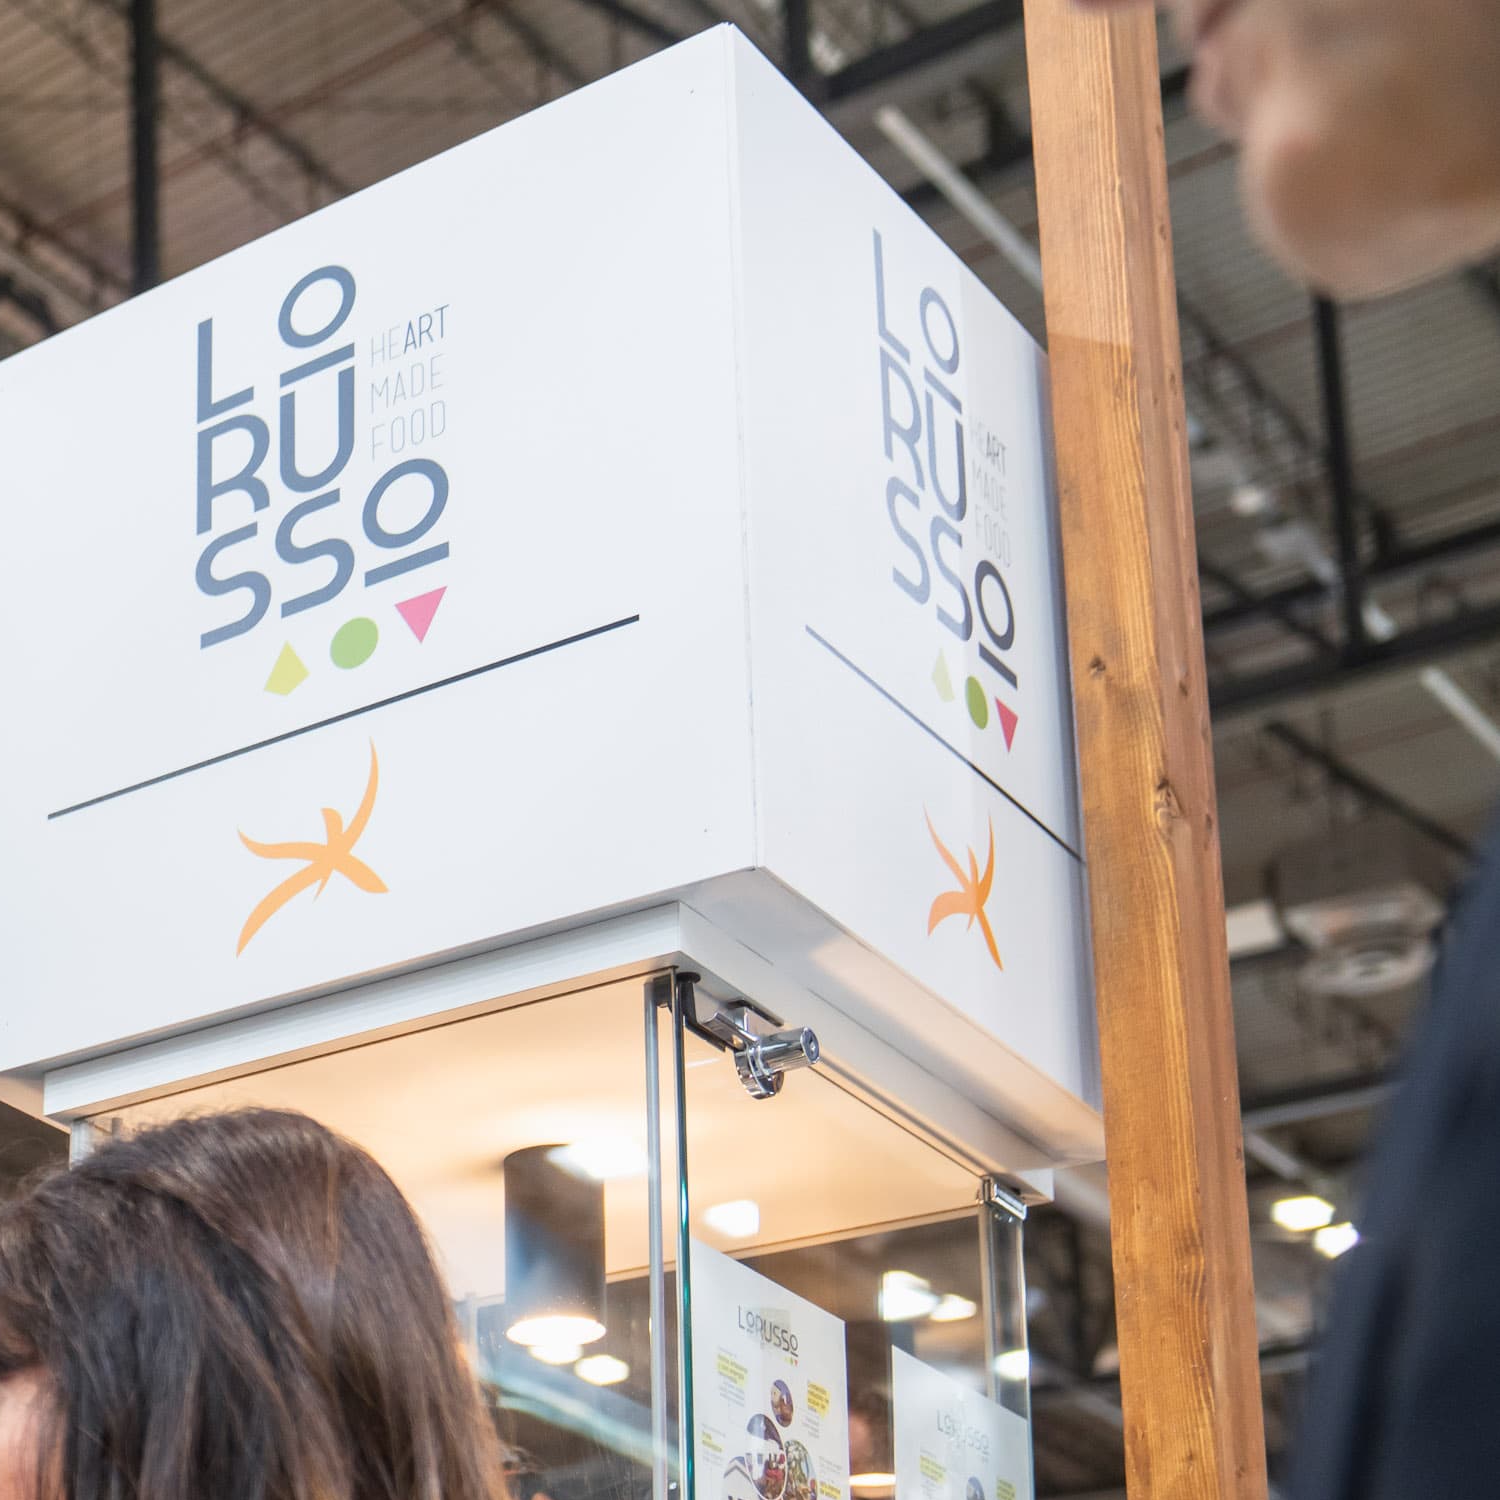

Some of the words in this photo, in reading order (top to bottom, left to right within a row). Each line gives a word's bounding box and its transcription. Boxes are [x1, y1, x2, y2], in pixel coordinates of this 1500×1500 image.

[370, 304, 450, 369] HEART
[371, 353, 447, 415] MADE
[371, 400, 446, 462] FOOD
[737, 1304, 800, 1358] LORUSSO
[936, 1409, 990, 1456] LOSSO
